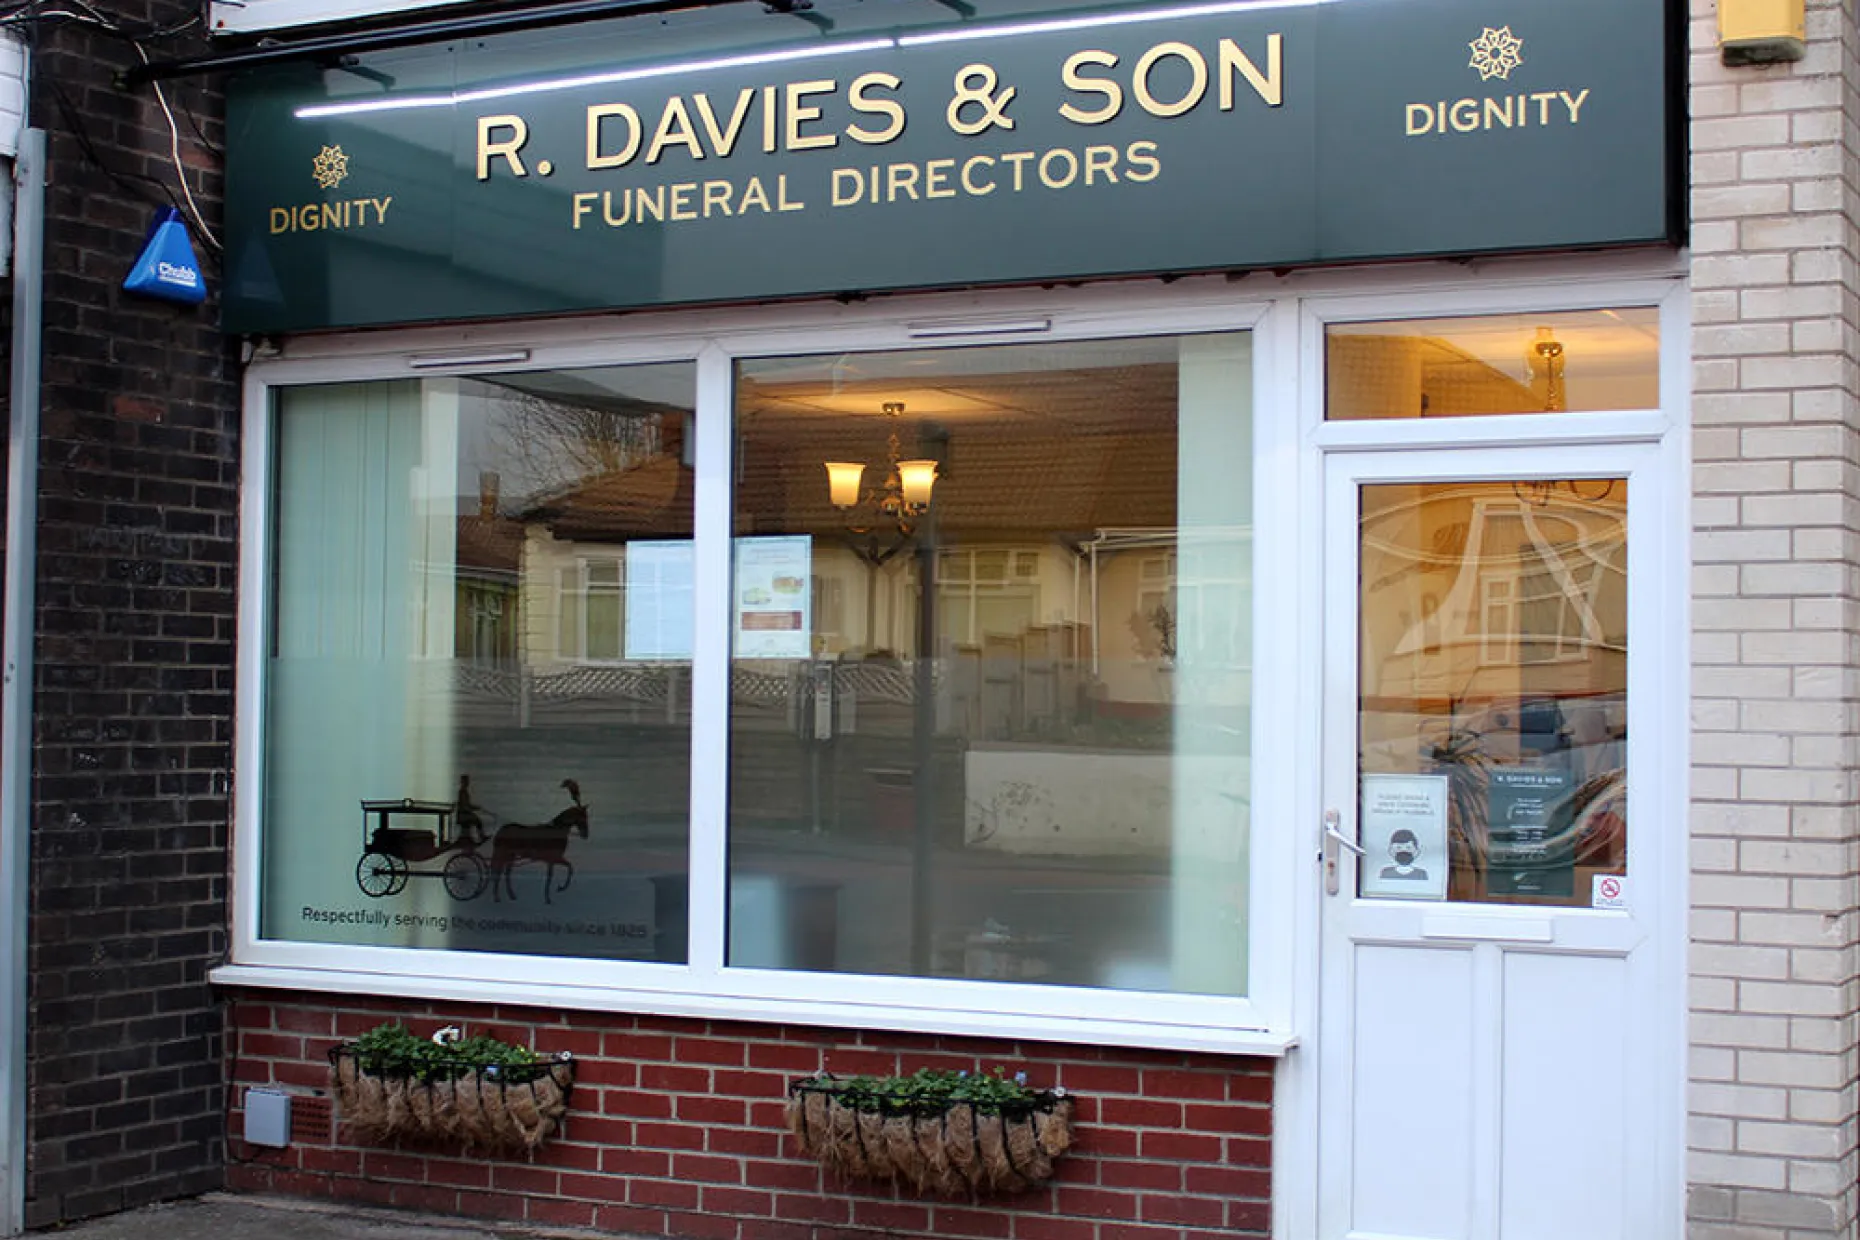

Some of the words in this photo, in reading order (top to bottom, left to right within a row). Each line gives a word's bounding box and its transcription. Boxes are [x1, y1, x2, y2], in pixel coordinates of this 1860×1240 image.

[475, 114, 553, 181] R.
[586, 71, 907, 171] DAVIES
[946, 63, 1017, 135] &
[1059, 33, 1285, 124] SON
[1404, 87, 1591, 137] DIGNITY
[572, 174, 806, 230] FUNERAL
[831, 140, 1163, 207] DIRECTORS
[269, 196, 393, 234] DIGNITY
[302, 907, 391, 928] Respectfully
[394, 914, 447, 932] serving
